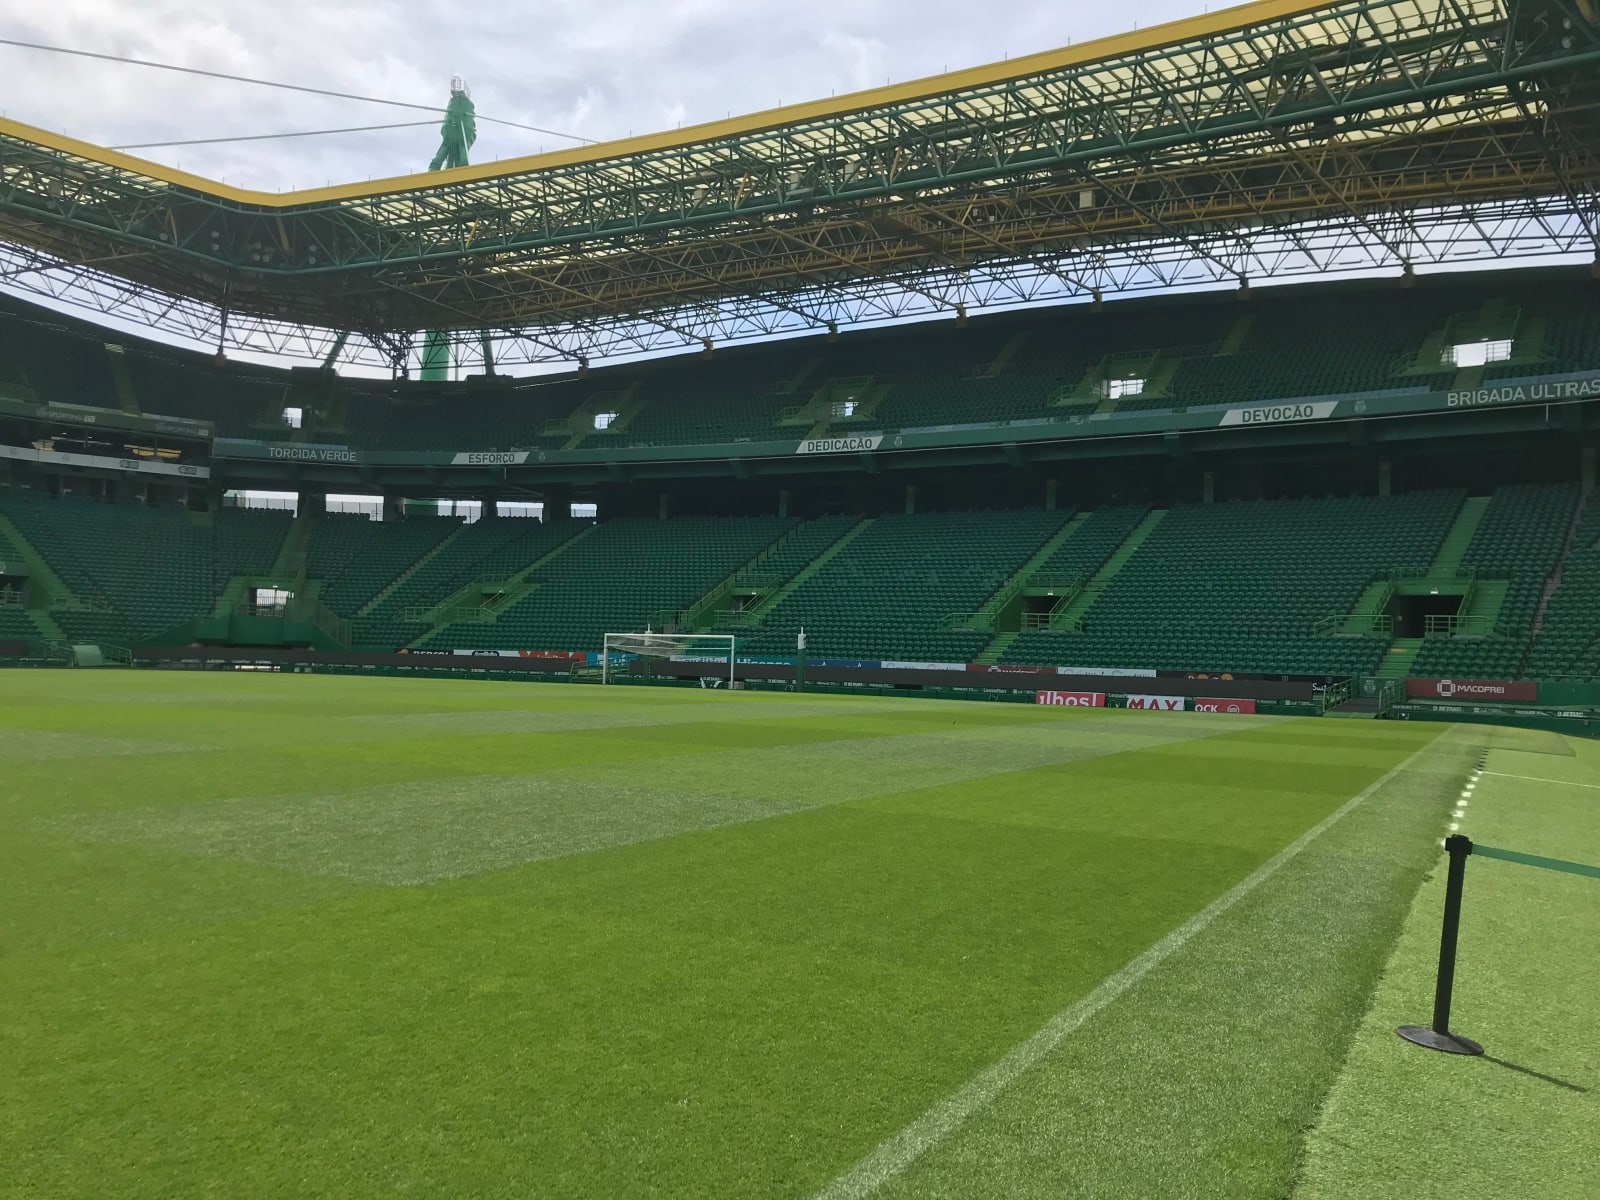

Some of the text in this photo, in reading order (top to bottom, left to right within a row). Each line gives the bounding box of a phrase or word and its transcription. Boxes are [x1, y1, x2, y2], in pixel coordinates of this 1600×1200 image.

[1447, 379, 1600, 407] BRIGADA ULTRAS
[269, 447, 357, 462] TORCIDA VERDE
